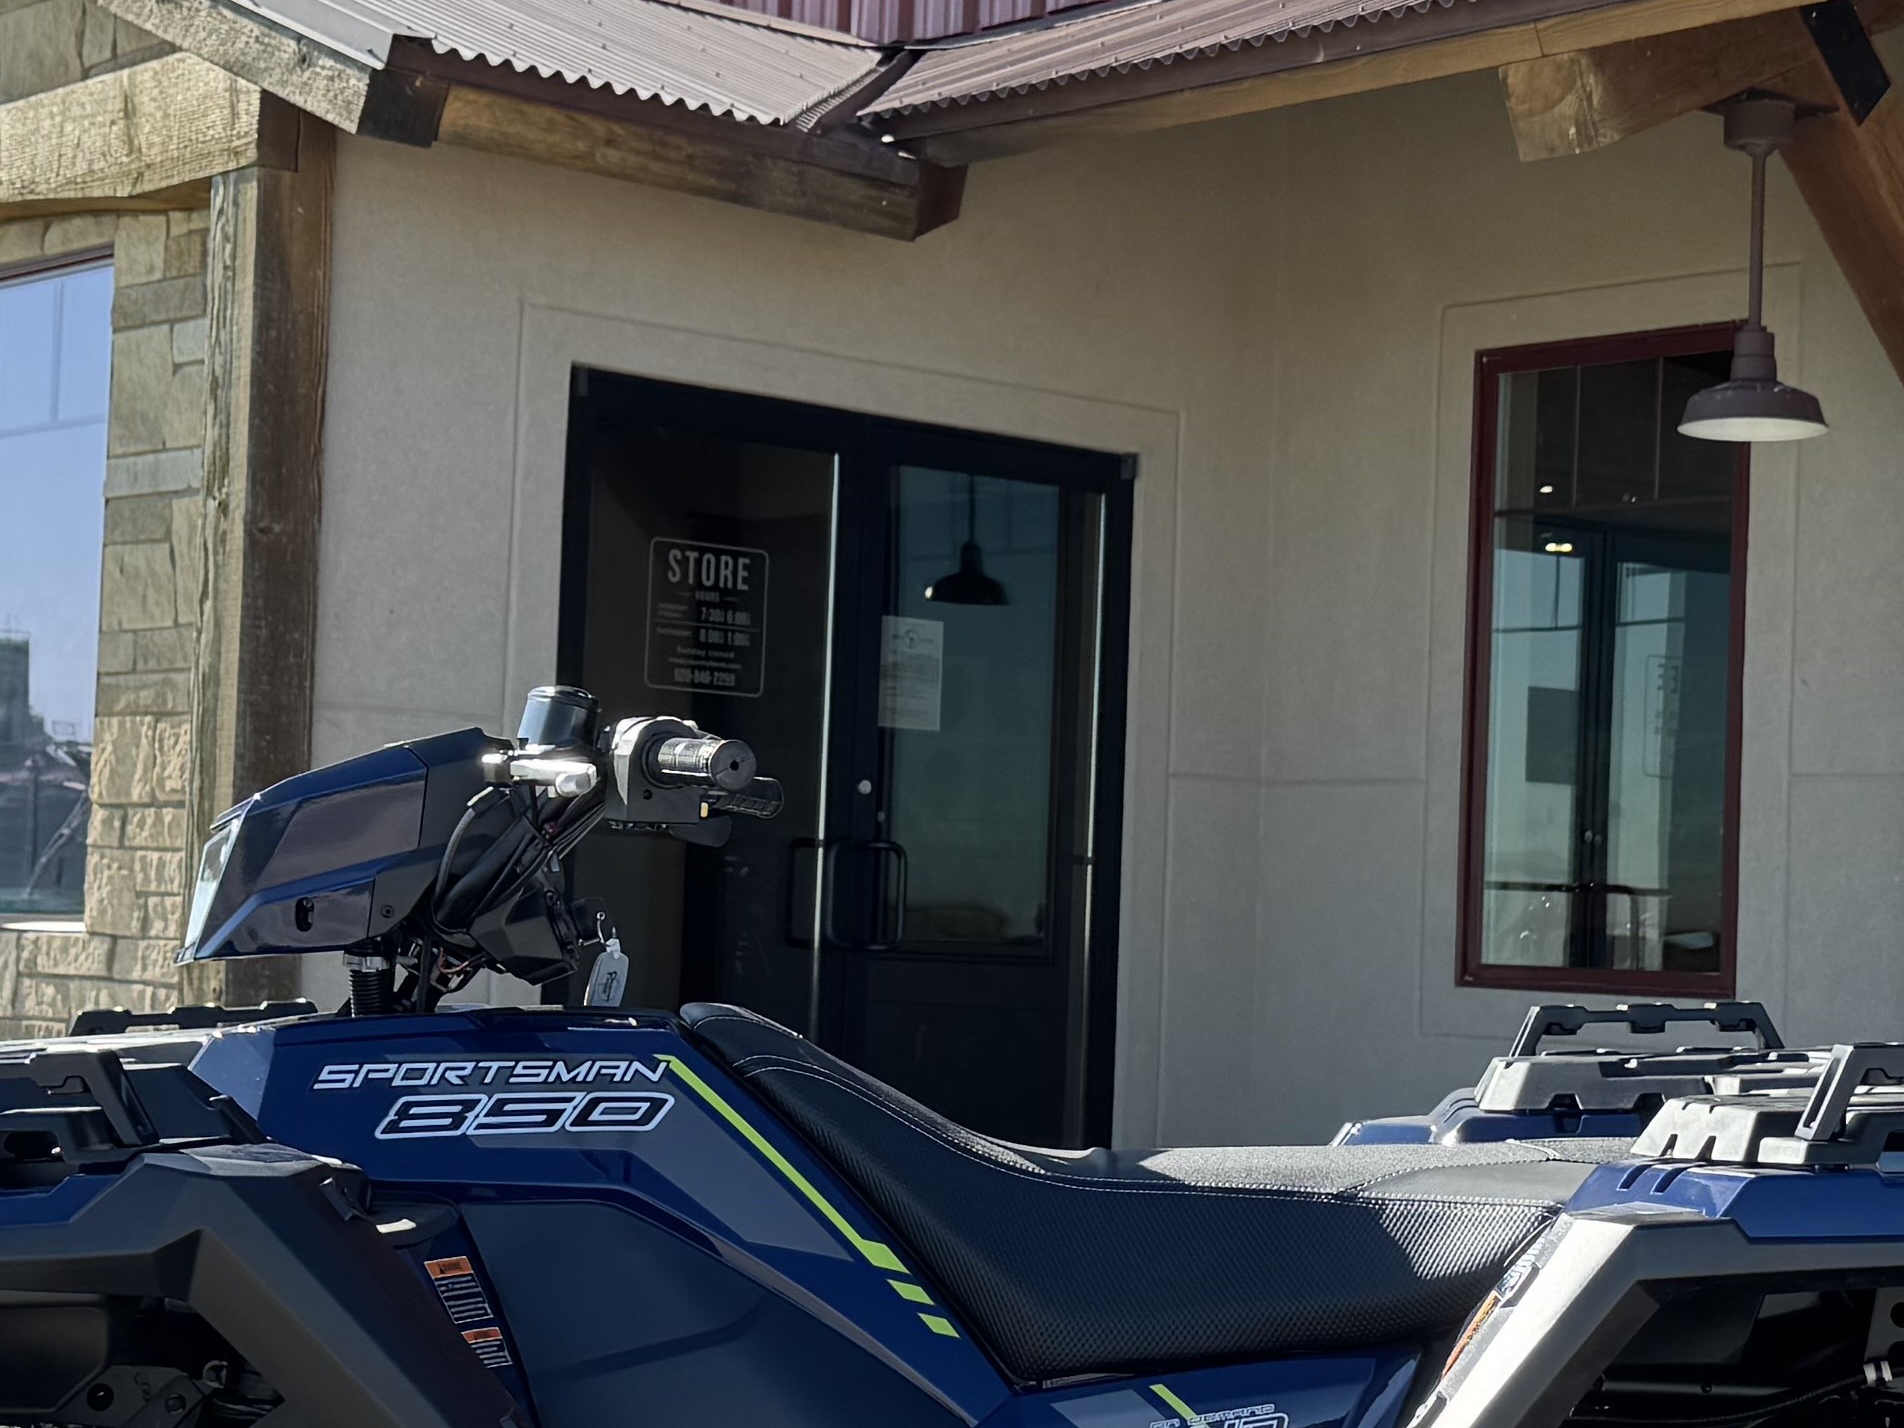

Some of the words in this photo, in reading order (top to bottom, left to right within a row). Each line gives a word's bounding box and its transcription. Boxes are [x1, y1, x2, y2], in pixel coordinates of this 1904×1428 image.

[667, 549, 751, 591] STORE
[313, 1059, 671, 1091] SPORTSMAN
[374, 1092, 676, 1140] 850
